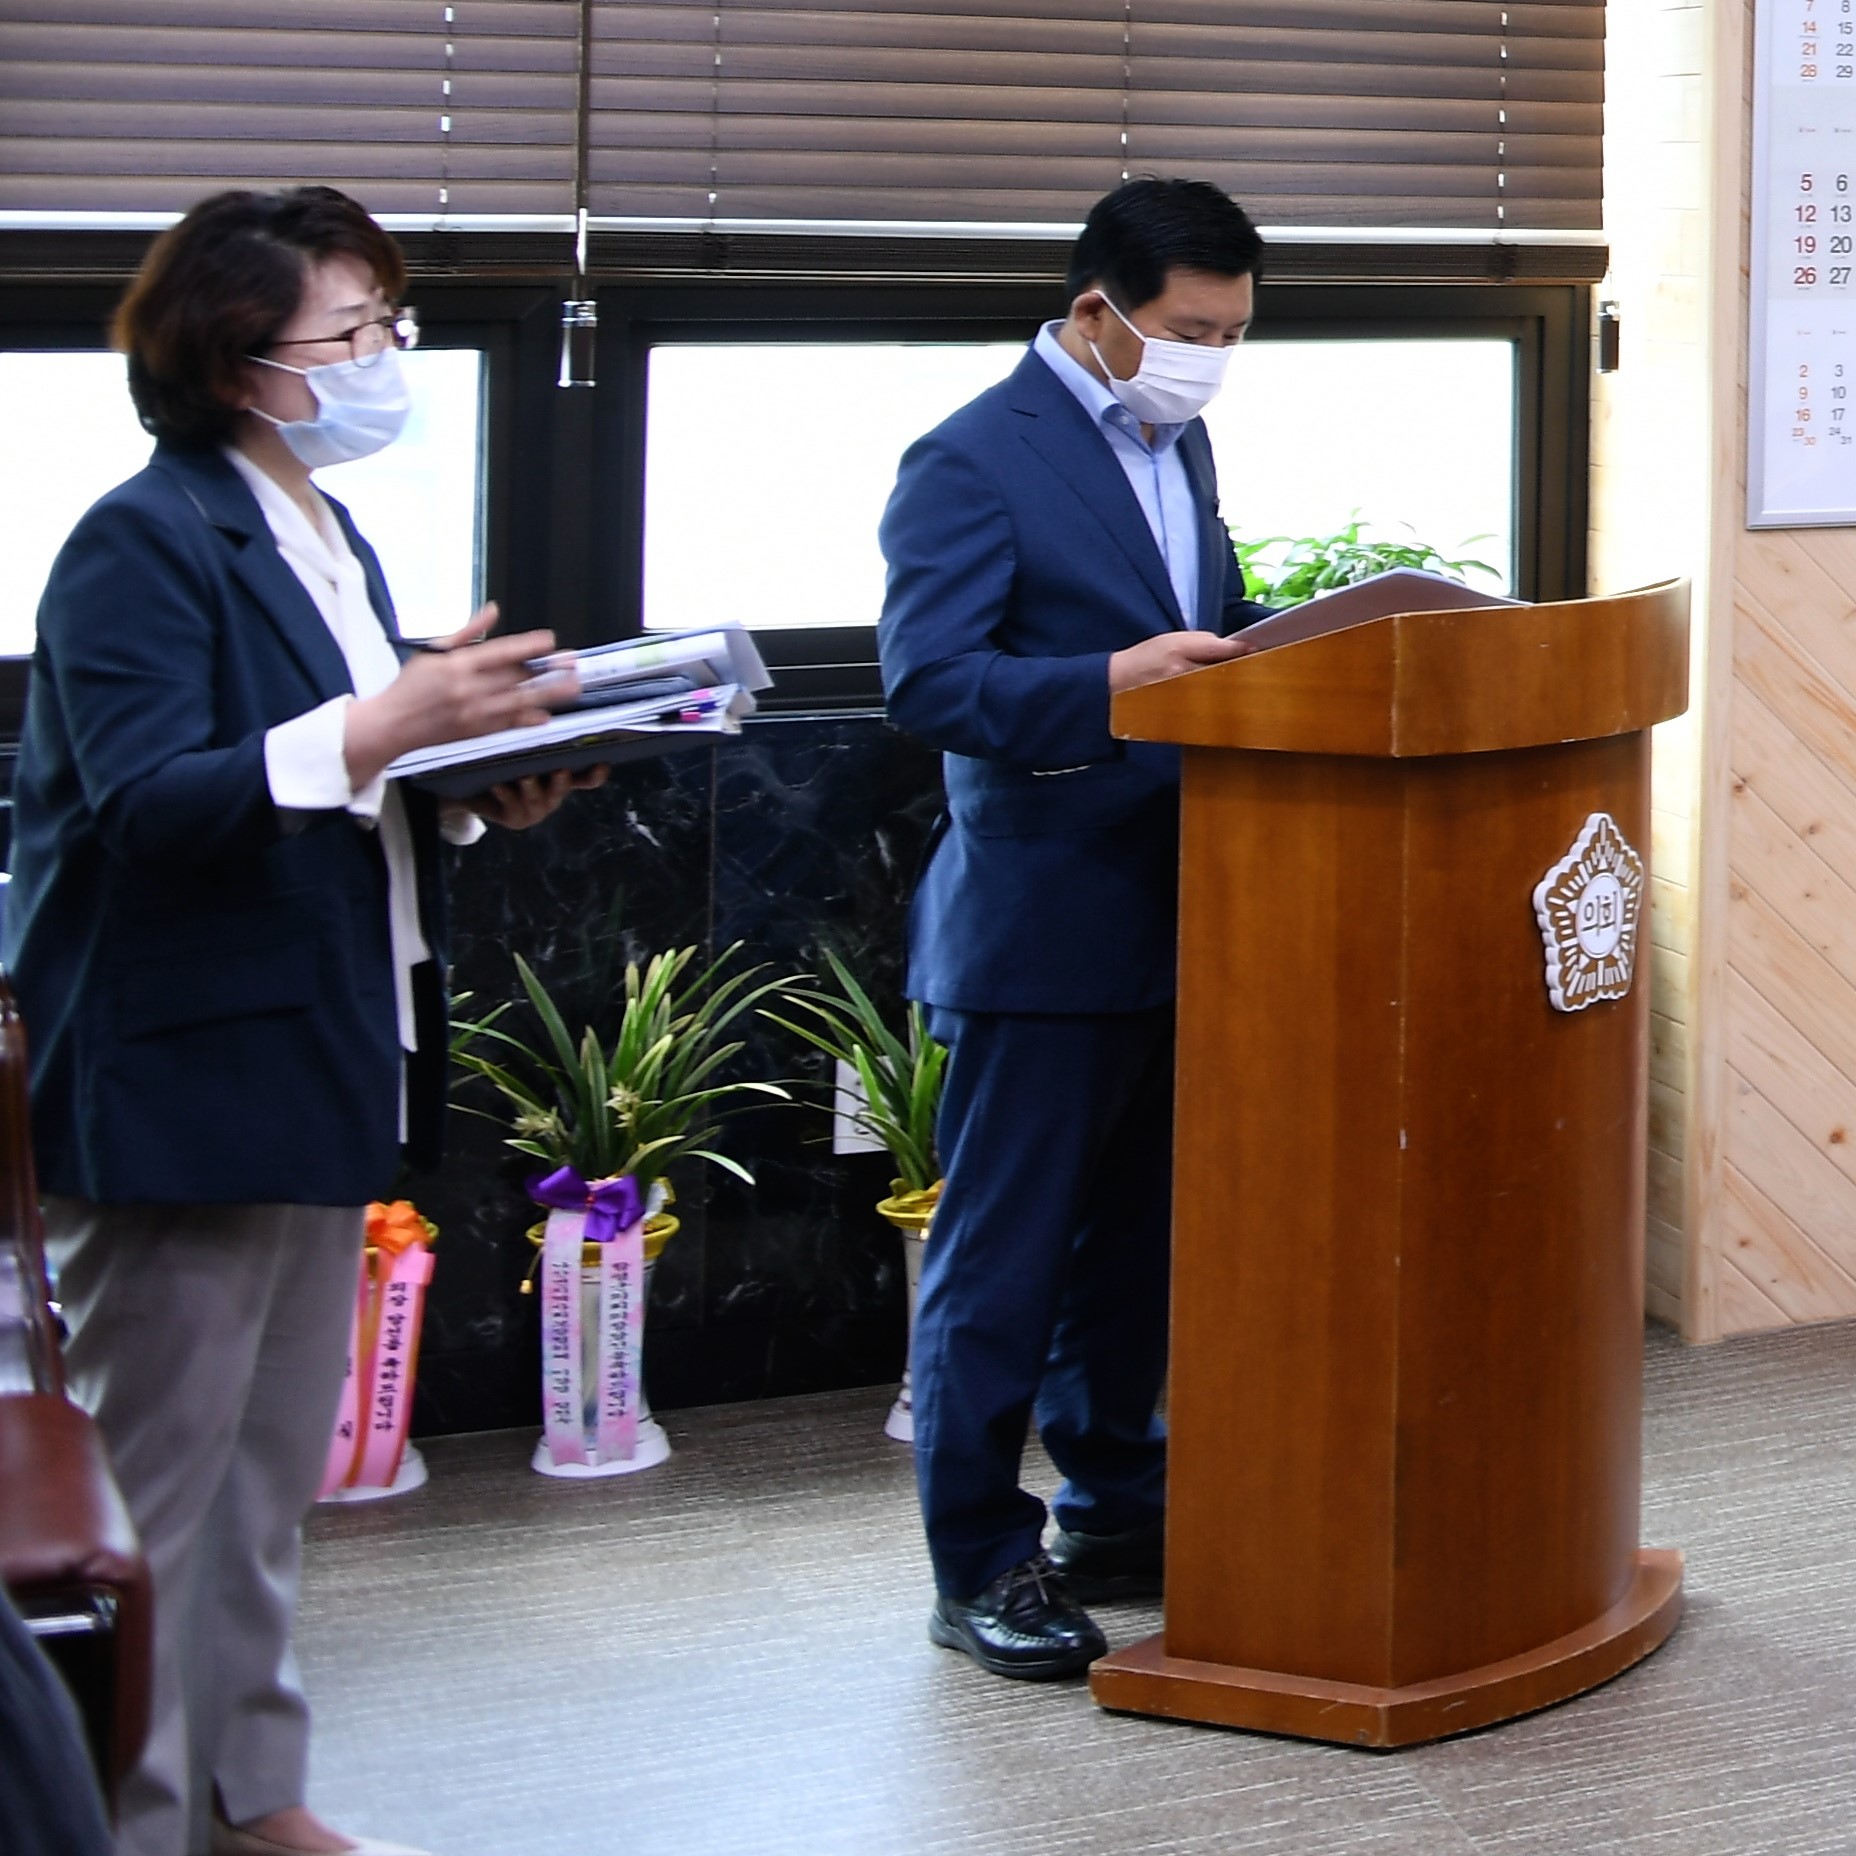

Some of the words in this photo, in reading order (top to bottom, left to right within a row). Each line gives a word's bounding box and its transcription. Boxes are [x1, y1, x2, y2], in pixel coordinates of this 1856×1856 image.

[1806, 0, 1814, 11] 7
[1842, 0, 1850, 13] 8
[1803, 22, 1816, 33] 14
[1838, 22, 1853, 35] 15
[1802, 42, 1816, 55] 21
[1836, 43, 1853, 56] 22
[1800, 64, 1817, 77] 28
[1836, 65, 1853, 78] 29
[1801, 174, 1812, 191] 5
[1836, 174, 1847, 191] 6
[1796, 205, 1816, 222] 12
[1831, 205, 1851, 222] 13
[1795, 236, 1816, 253] 19
[1830, 236, 1852, 253] 20
[1794, 267, 1816, 284] 26
[1829, 267, 1851, 284] 27
[1800, 365, 1808, 378] 2
[1835, 364, 1843, 377] 3
[1799, 387, 1808, 400] 9
[1831, 386, 1846, 399] 10
[1796, 409, 1810, 422] 16
[1832, 408, 1845, 420] 17
[1581, 890, 1618, 936] 의회
